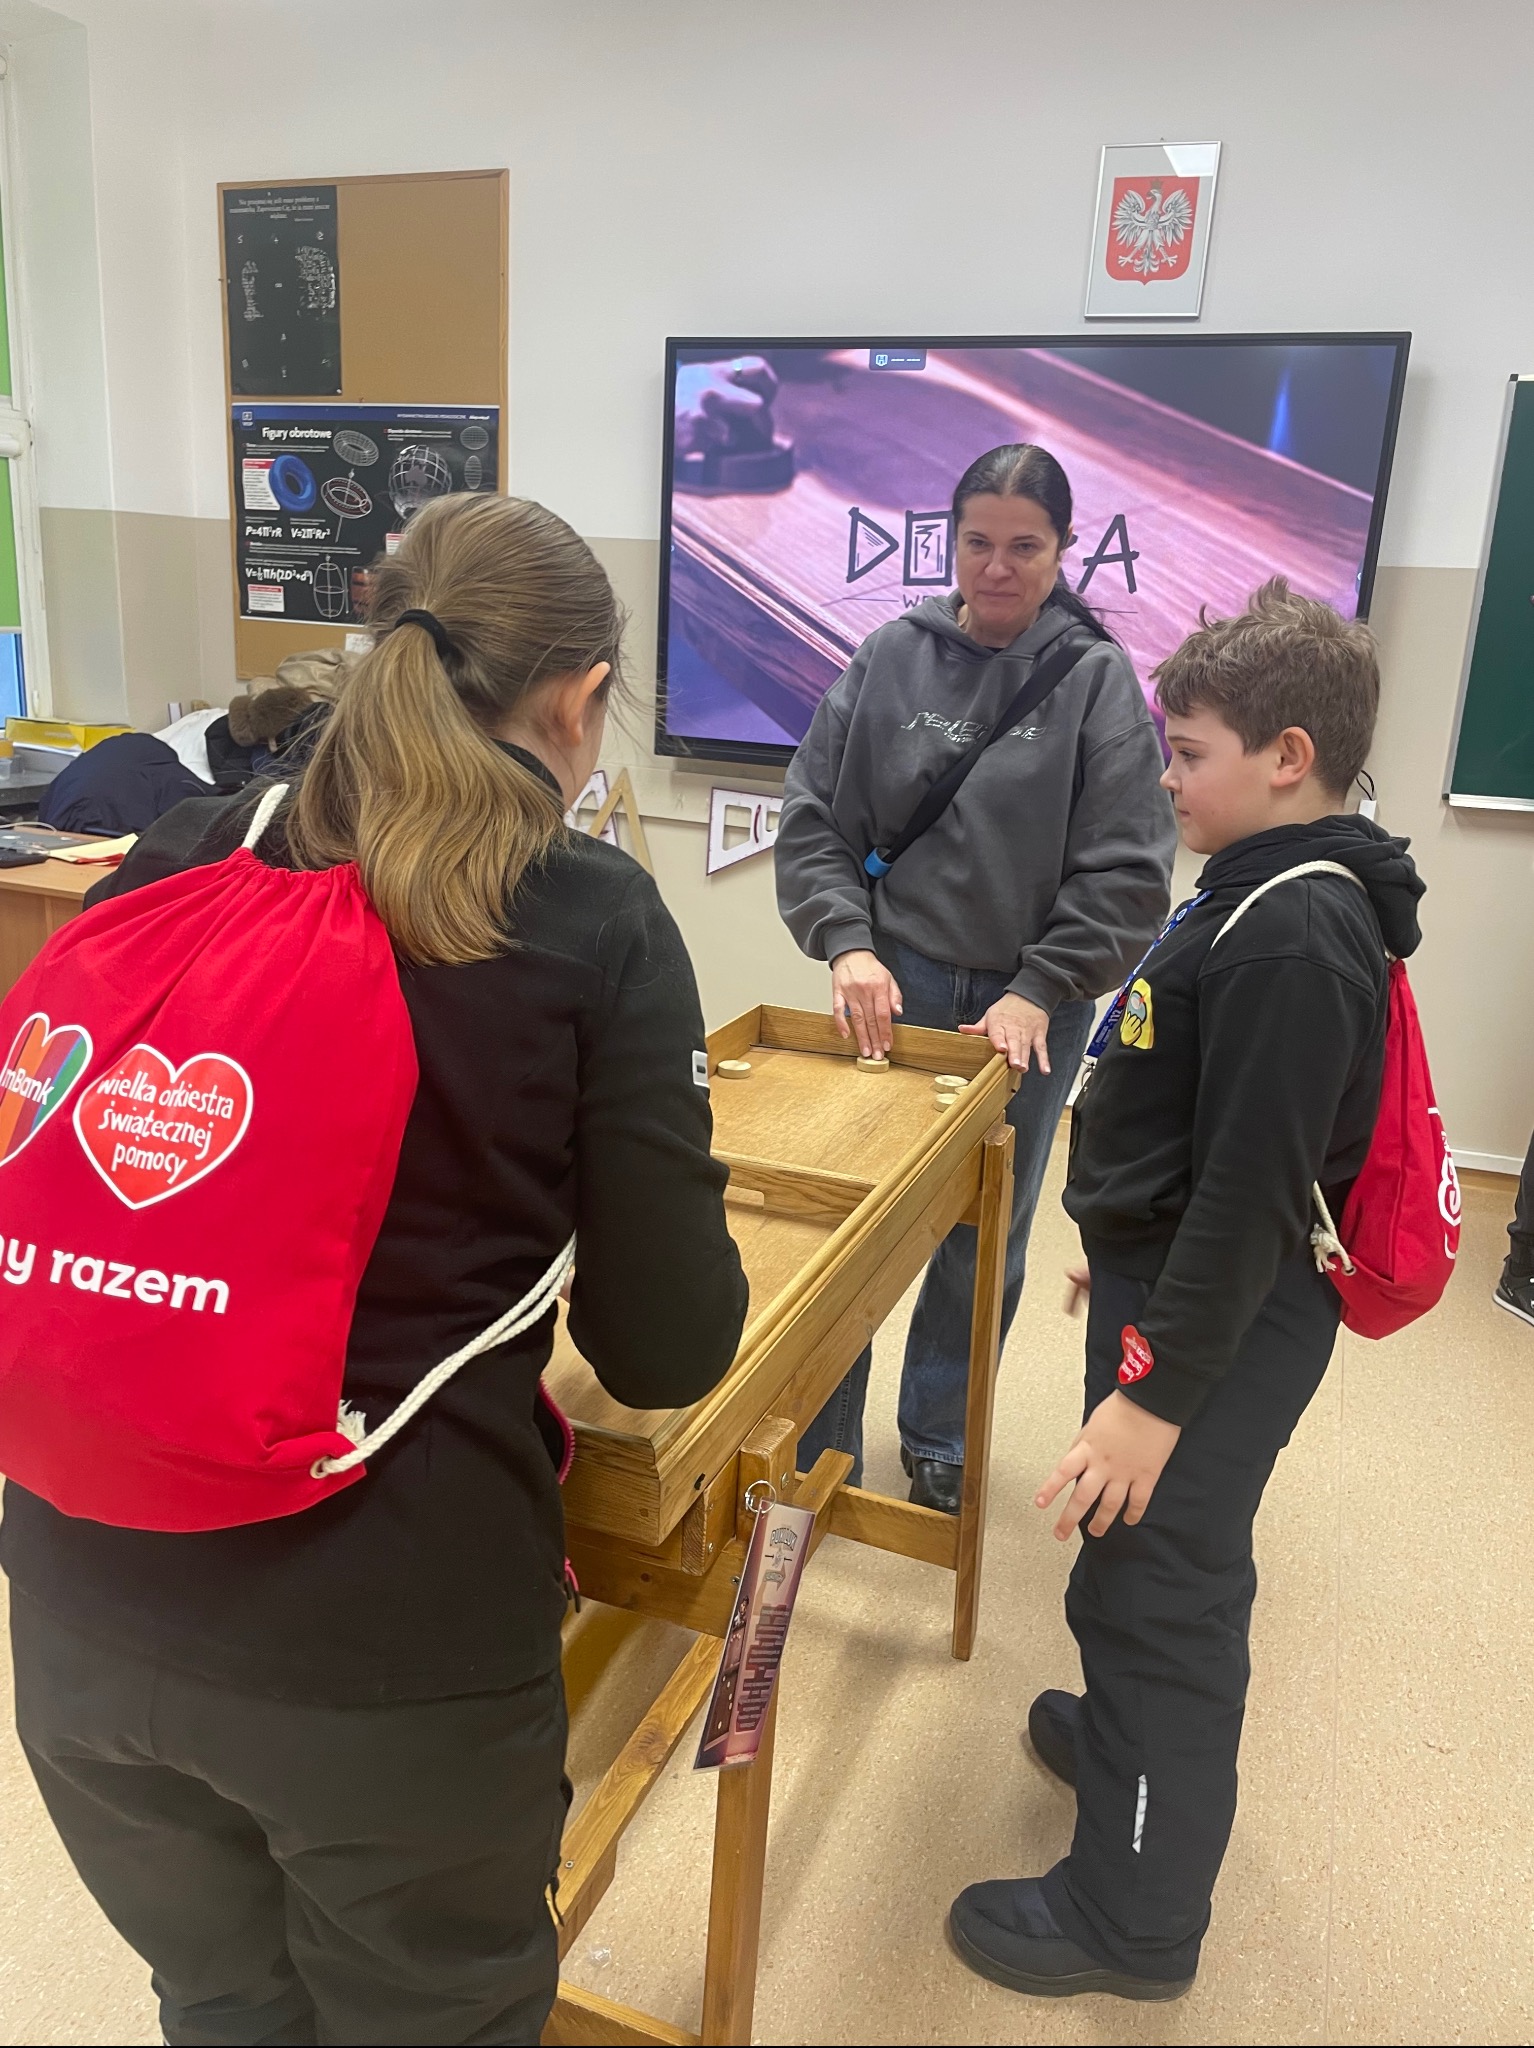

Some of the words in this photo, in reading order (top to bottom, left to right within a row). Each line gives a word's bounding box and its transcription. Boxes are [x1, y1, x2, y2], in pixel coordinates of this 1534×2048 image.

[262, 427, 288, 440] Figury
[289, 427, 332, 439] obrotowe
[1, 1067, 55, 1106] mBank
[96, 1070, 157, 1104] wielka
[158, 1080, 234, 1119] orkiestra
[98, 1100, 214, 1161] świątecznej
[111, 1142, 188, 1184] pomocy
[49, 1248, 230, 1315] razem
